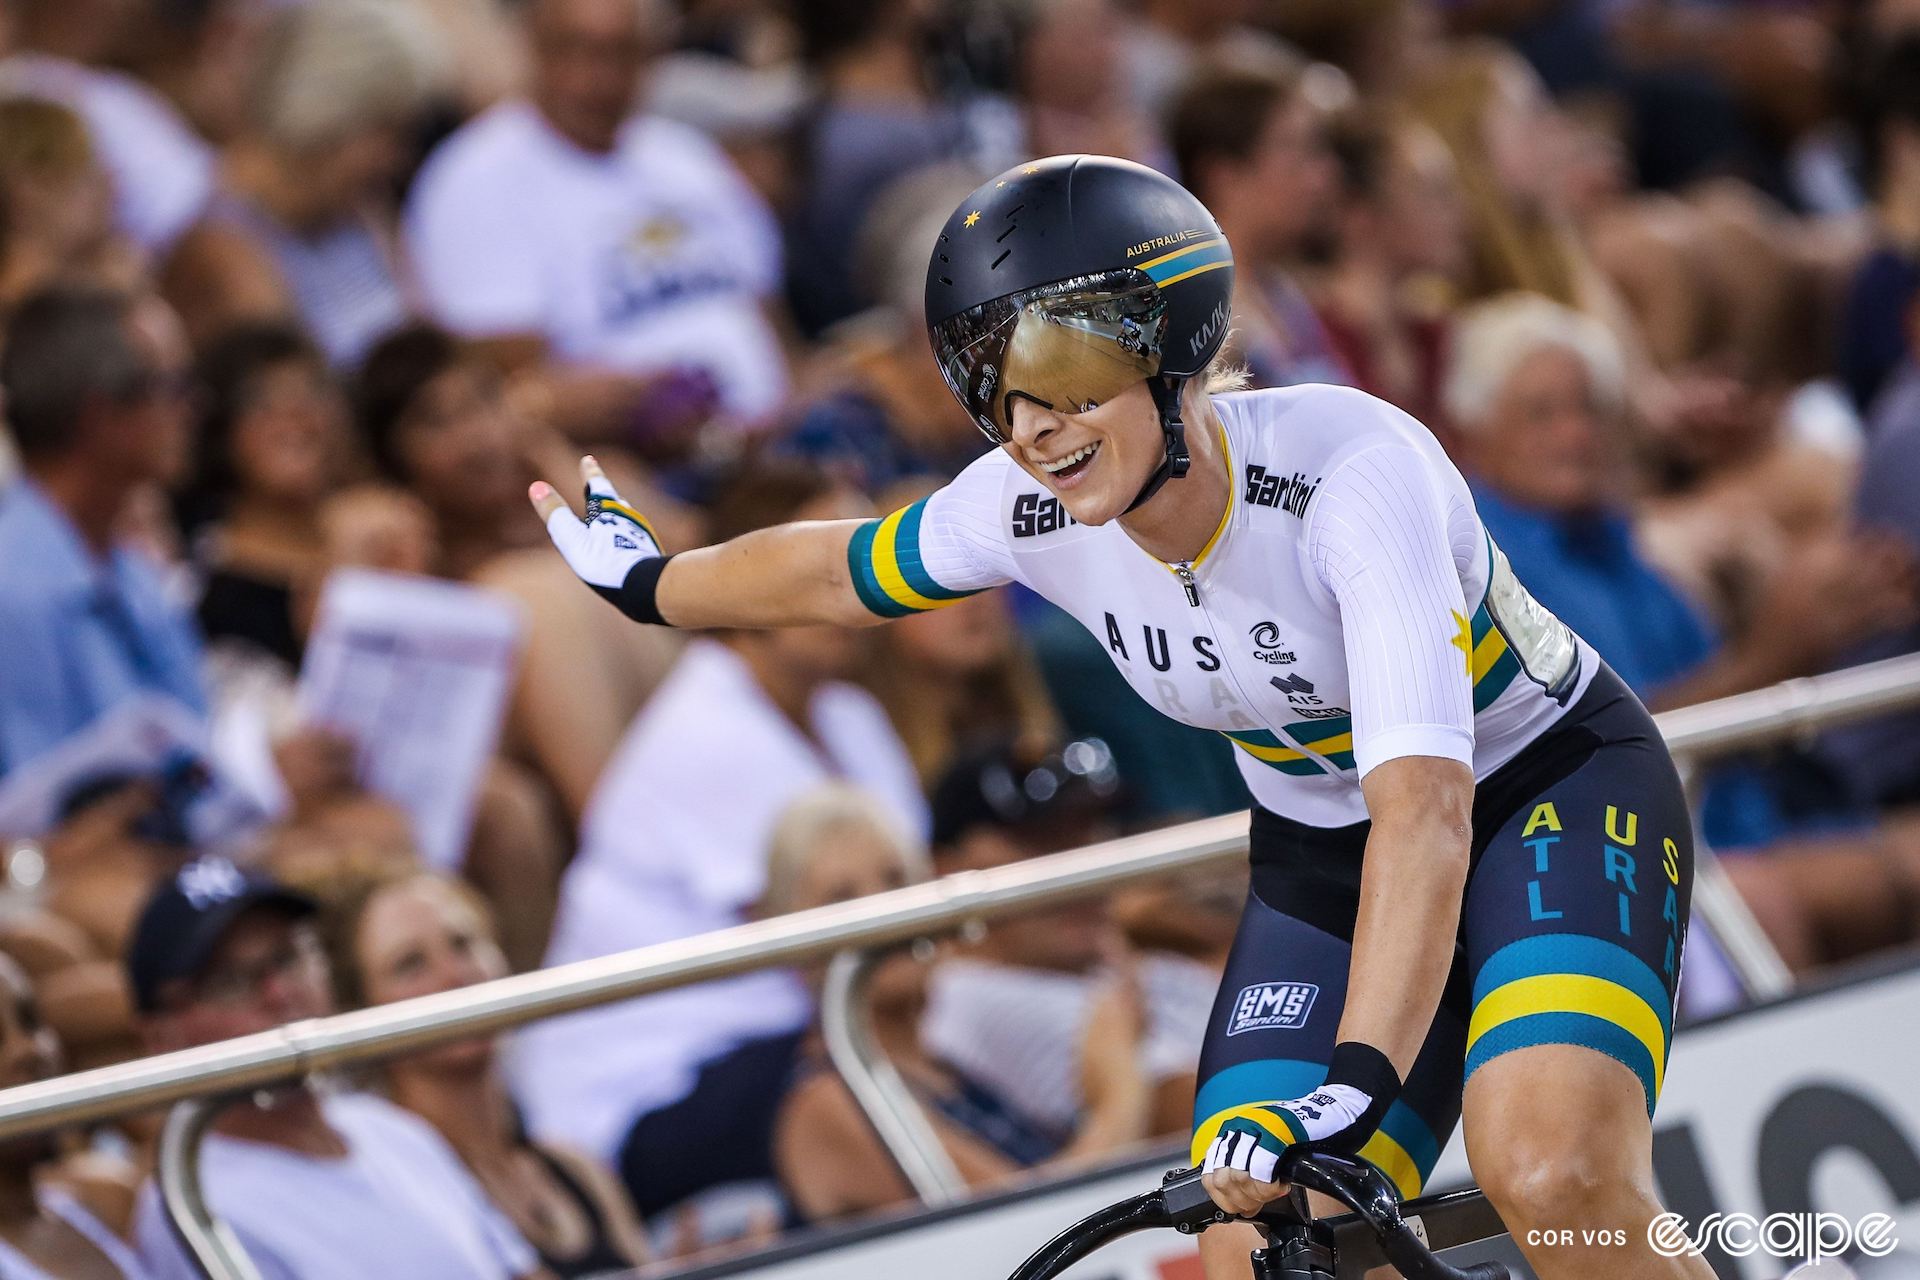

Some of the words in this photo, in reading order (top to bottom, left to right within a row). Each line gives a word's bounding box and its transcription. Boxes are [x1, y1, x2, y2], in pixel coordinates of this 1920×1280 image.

[1126, 231, 1187, 258] AUSTRALIA
[1245, 464, 1322, 519] Santini
[1105, 612, 1221, 672] AUS
[1253, 651, 1297, 662] Cycling
[1287, 695, 1324, 705] AIS
[1521, 801, 1679, 885] AUS
[1237, 986, 1309, 1020] SMS
[1235, 1015, 1297, 1030] Santini
